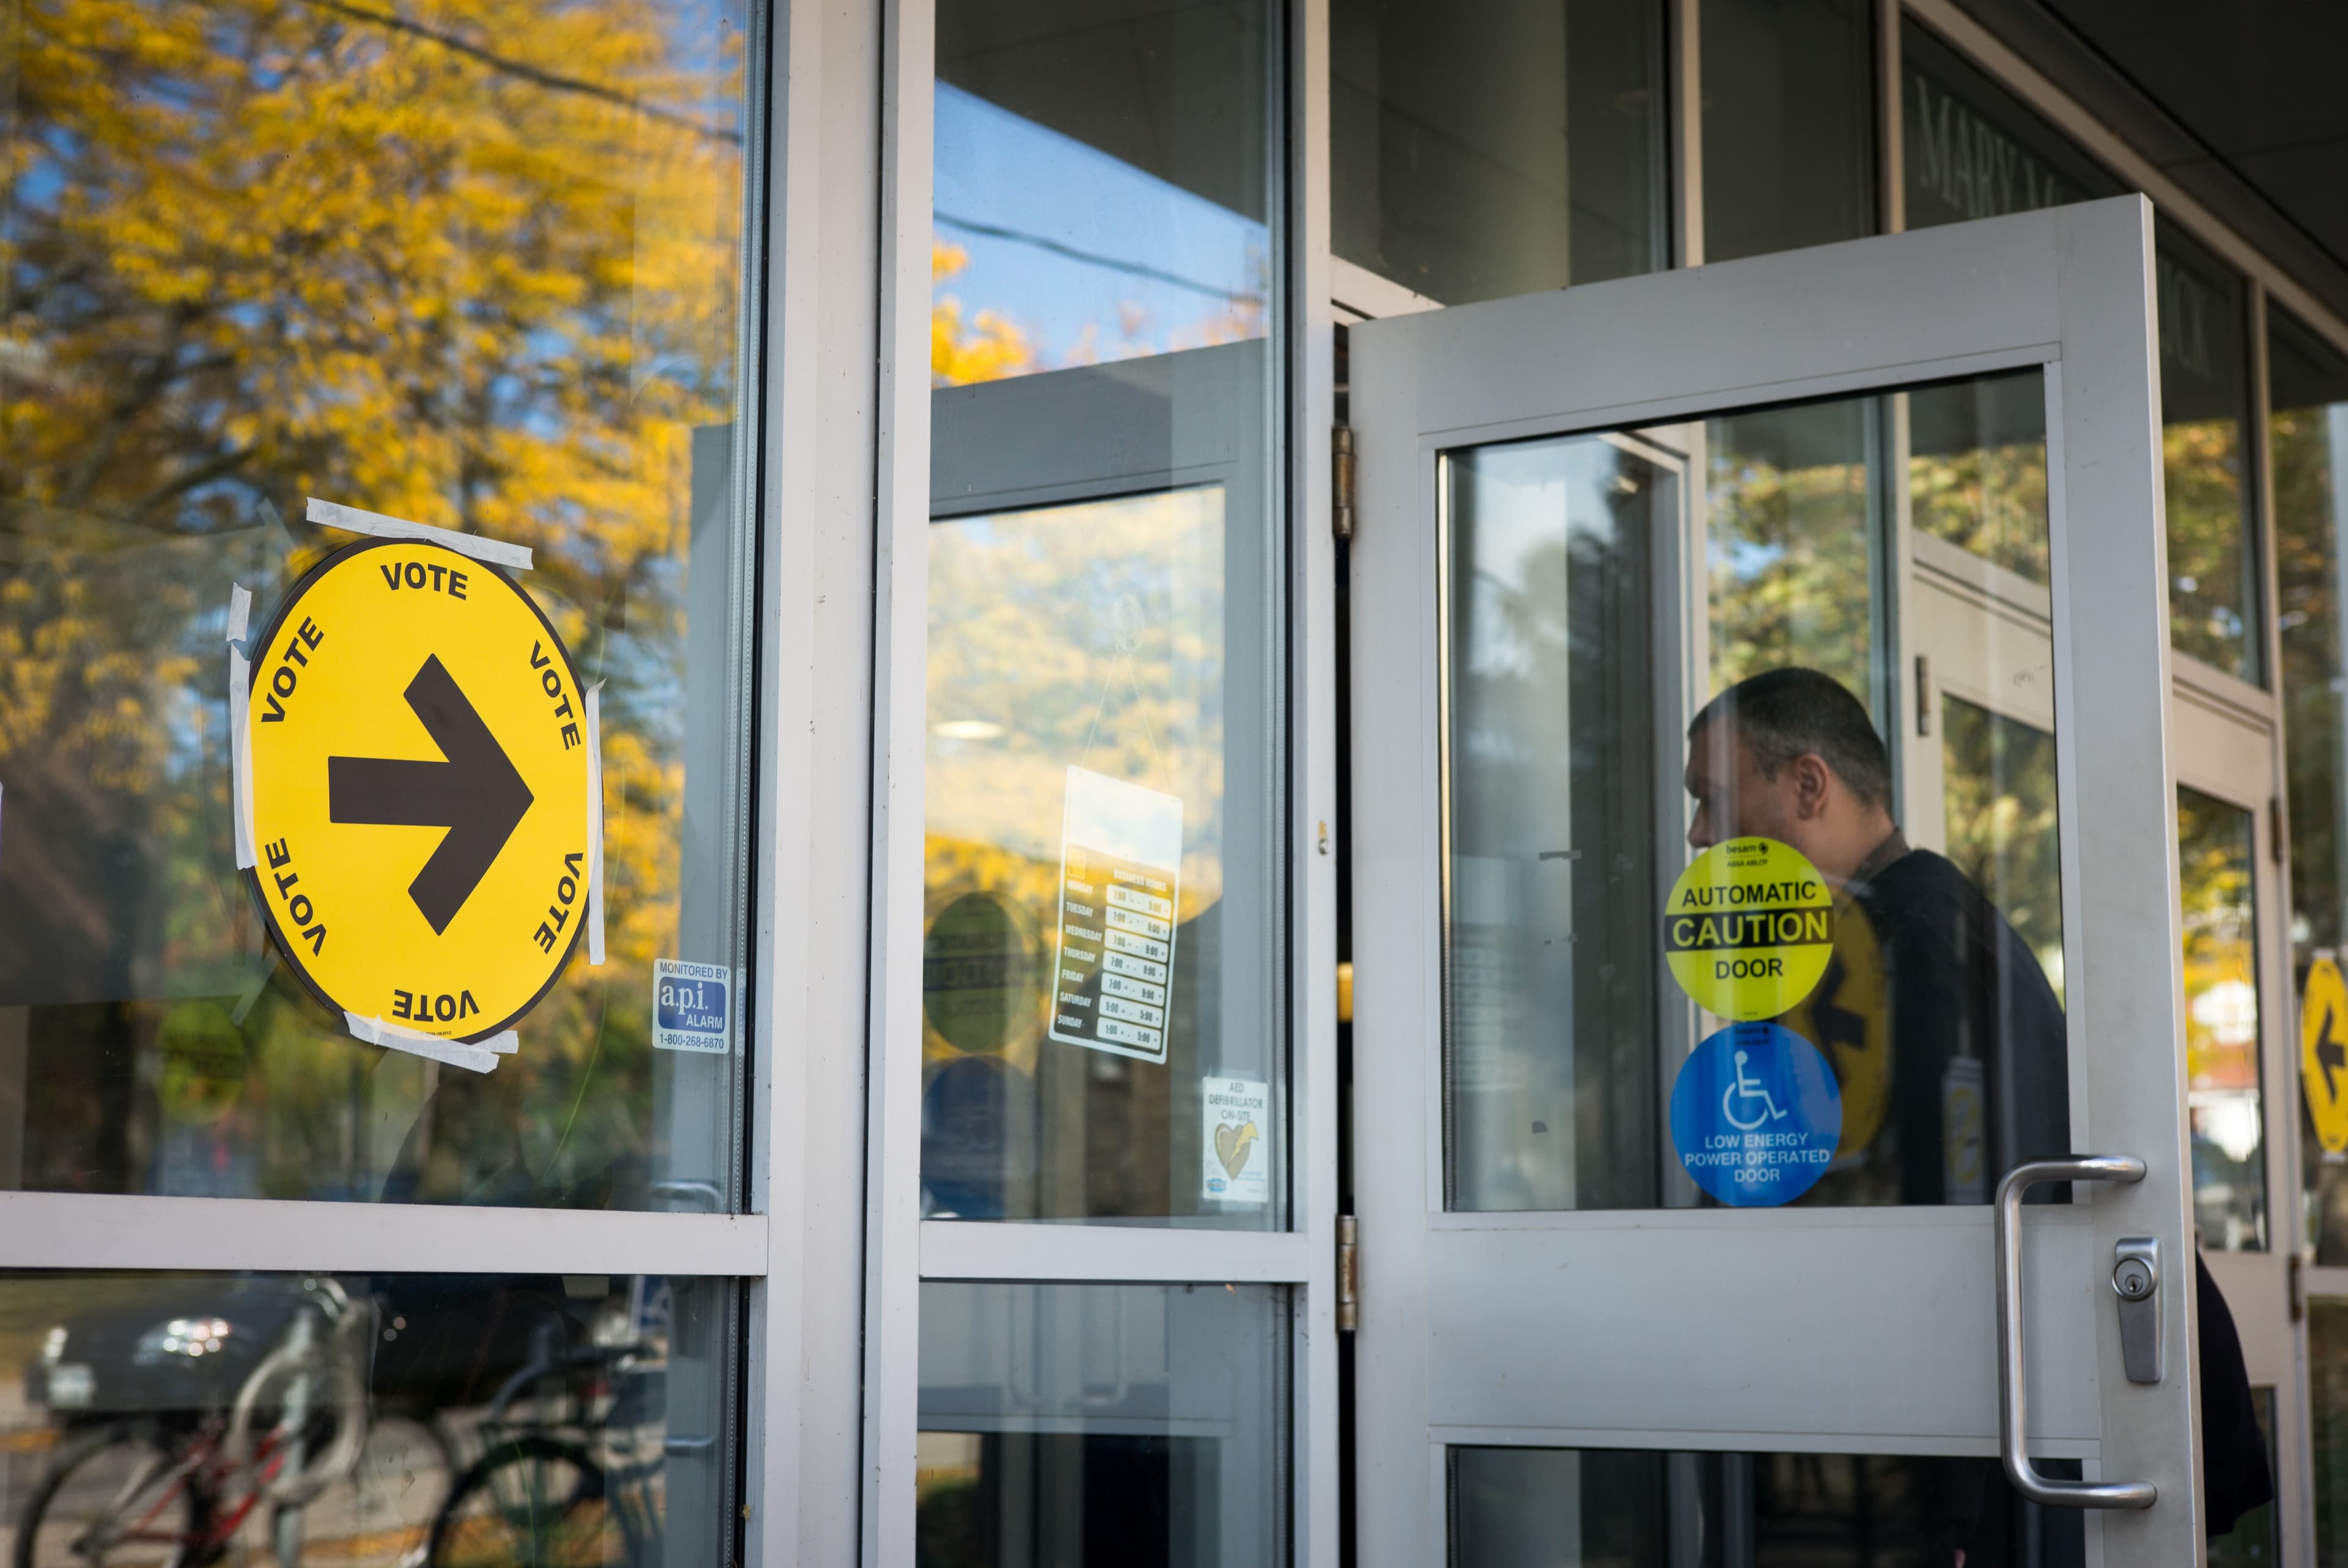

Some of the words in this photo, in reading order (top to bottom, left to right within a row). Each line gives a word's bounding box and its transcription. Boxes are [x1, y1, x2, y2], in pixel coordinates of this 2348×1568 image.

[380, 562, 468, 600] VOTE
[261, 616, 324, 723] VOTE
[530, 639, 581, 751] VOTE
[1726, 845, 1756, 853] besam
[265, 837, 327, 957] VOTE
[1067, 879, 1094, 896] MONDAY
[1682, 881, 1817, 907] AUTOMATIC
[533, 852, 583, 955] VOTE
[1066, 901, 1093, 918] TUESDAY
[1672, 910, 1828, 948] CAUTION
[1065, 924, 1102, 942] WEDNESDAY
[1113, 935, 1126, 947] 7:00
[1145, 944, 1158, 957] 9:00
[1064, 946, 1096, 963] THURSDAY
[1111, 956, 1123, 969] 7:00
[660, 962, 714, 977] MONITORED
[716, 968, 728, 980] BY
[1715, 959, 1784, 980] DOOR
[1061, 969, 1084, 983] FRIDAY
[1109, 979, 1121, 990] 7:00
[1142, 988, 1154, 1000] 9:00
[392, 989, 480, 1023] VOTE
[1059, 991, 1092, 1008] SATURDAY
[1106, 1001, 1118, 1014] 9:00
[1140, 1009, 1153, 1022] 5:00
[686, 1014, 723, 1029] ALARM
[1057, 1014, 1082, 1029] SUNDAY
[1106, 1024, 1118, 1035] 1:00
[1137, 1031, 1150, 1043] 5:00
[660, 1033, 724, 1049] 1-800-268-6870
[1229, 1082, 1244, 1093] AED
[1209, 1094, 1263, 1109] DEFIBRILLATOR
[1221, 1110, 1251, 1121] ON-SITE
[1705, 1135, 1740, 1149] LOW
[1744, 1132, 1809, 1148] ENERGY
[1684, 1152, 1741, 1167] POWER
[1746, 1149, 1831, 1166] OPERATED
[1734, 1168, 1781, 1183] DOOR
